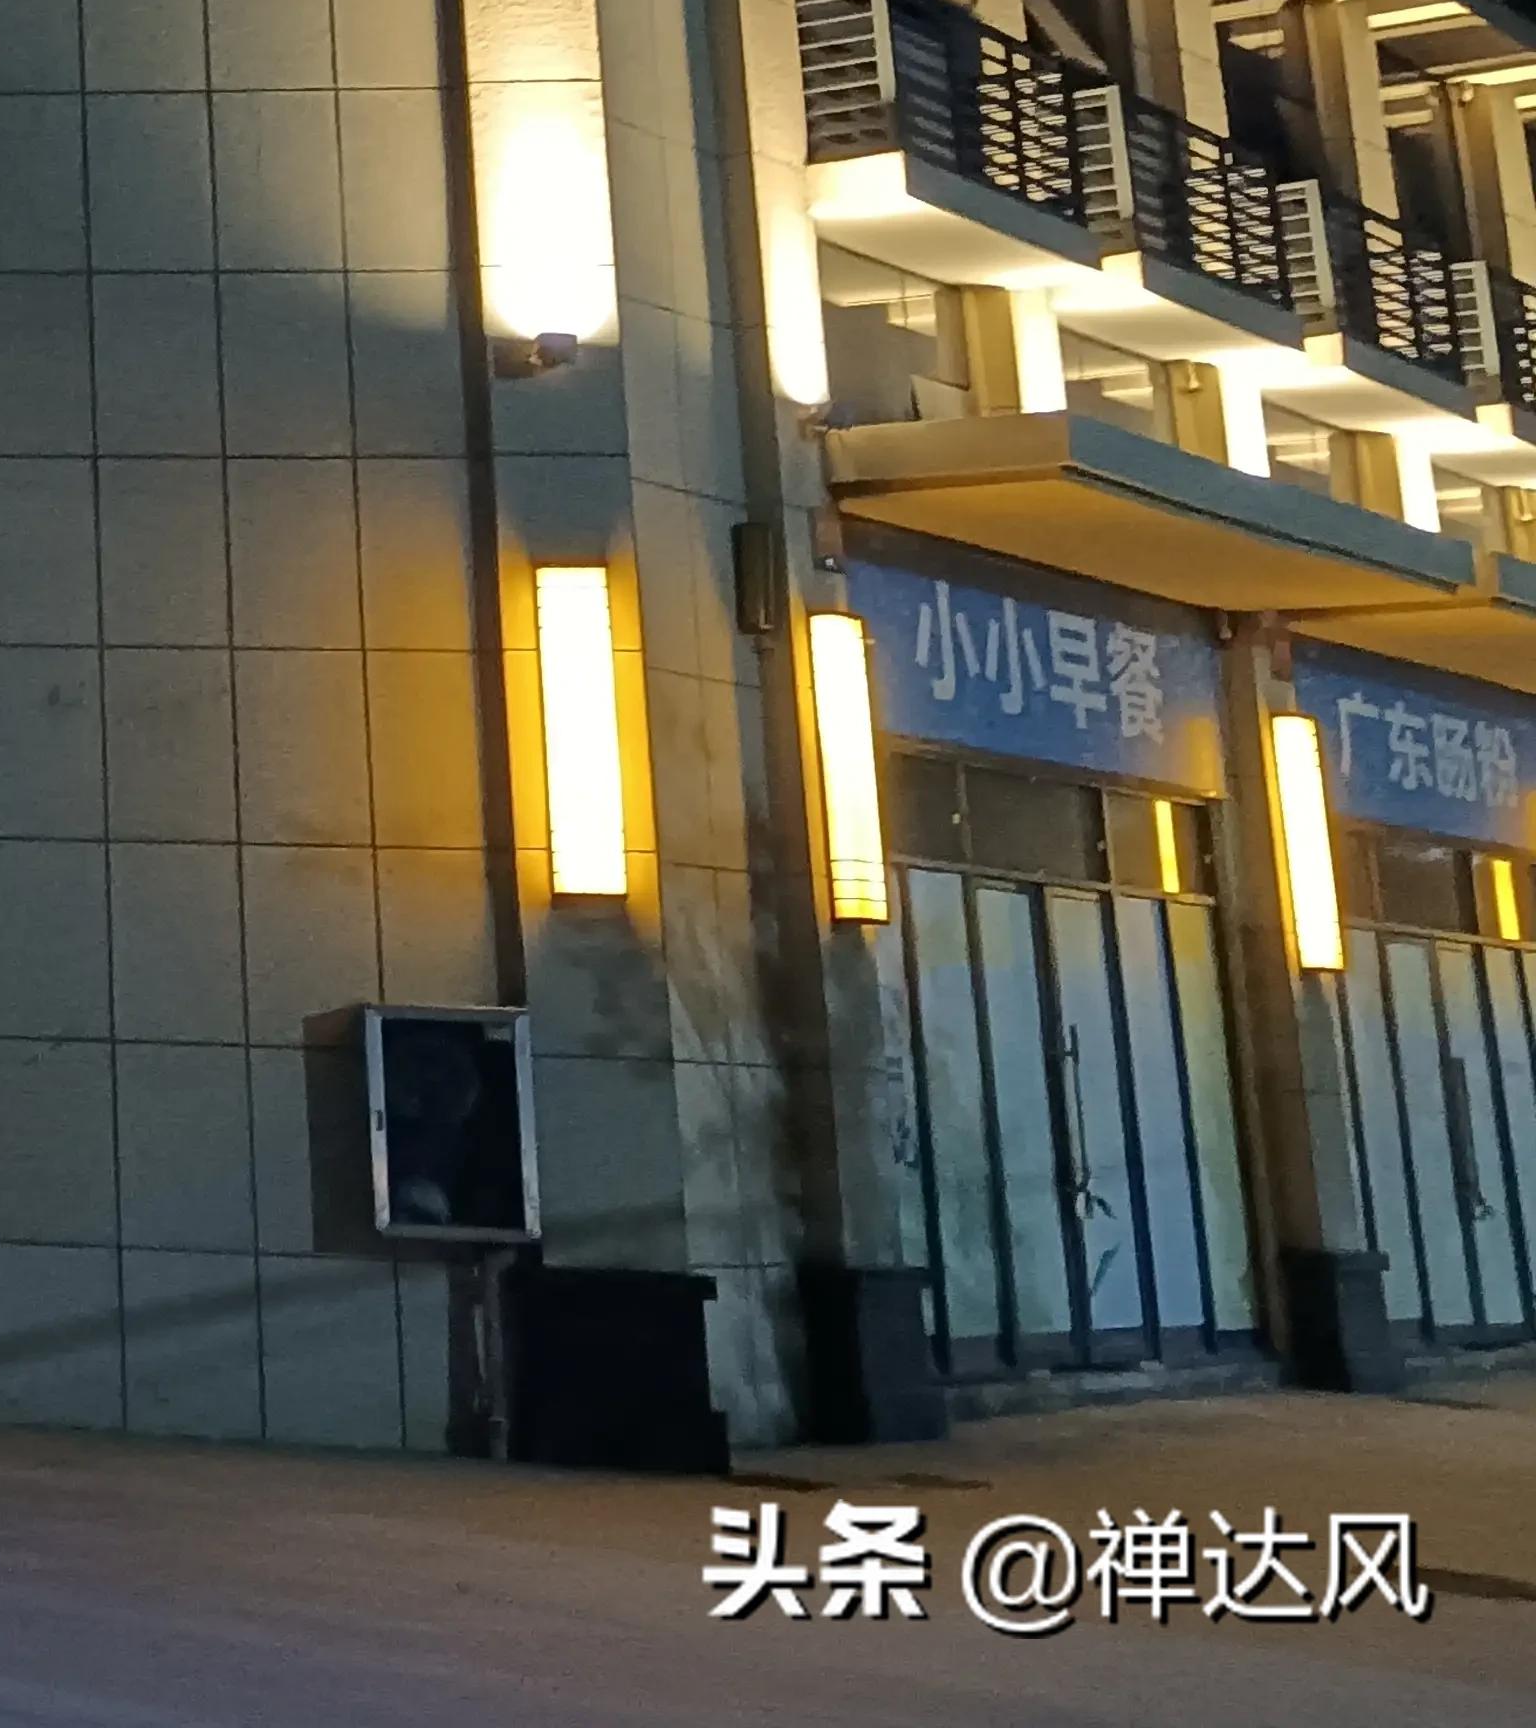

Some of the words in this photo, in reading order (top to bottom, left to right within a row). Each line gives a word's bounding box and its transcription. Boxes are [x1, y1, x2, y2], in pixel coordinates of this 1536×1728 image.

[915, 580, 1164, 744] 小小早餐
[1338, 693, 1518, 807] 广东肠粉
